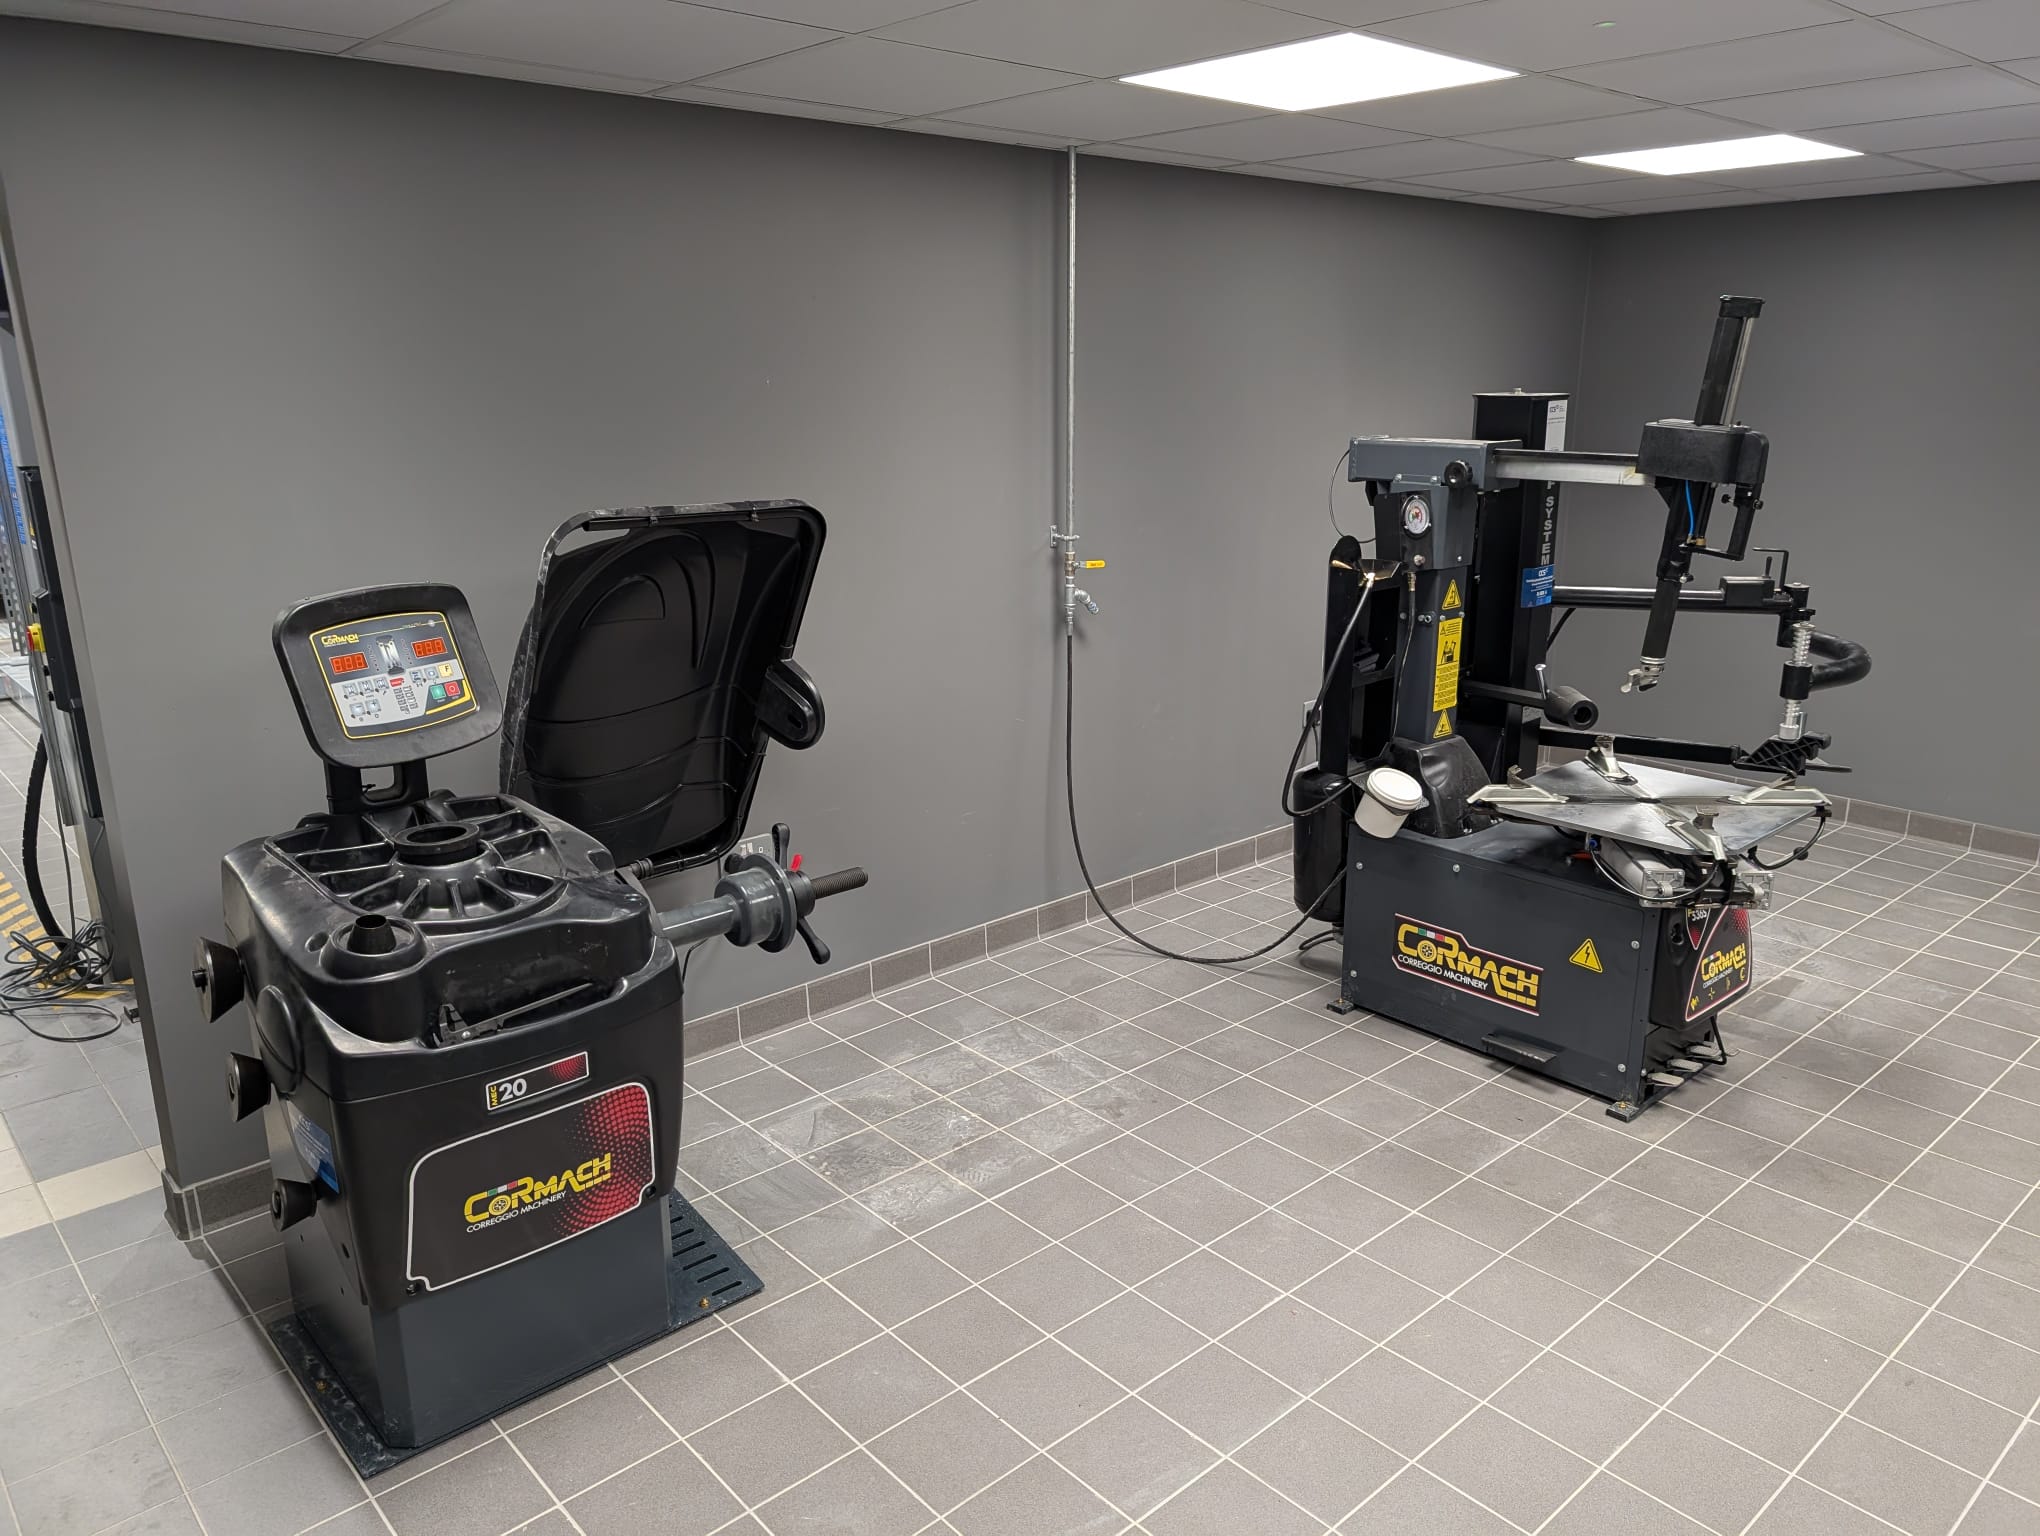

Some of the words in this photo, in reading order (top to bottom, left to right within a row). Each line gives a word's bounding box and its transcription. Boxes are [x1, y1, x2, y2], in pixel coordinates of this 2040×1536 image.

[1541, 496, 1555, 566] SYSTEM
[321, 633, 360, 645] CORMACH
[1397, 923, 1539, 1007] CORMACH
[1397, 954, 1442, 976] CORREGGIO
[1443, 969, 1489, 991] MACHINERY
[1701, 943, 1747, 981] CORMACH
[499, 1078, 527, 1102] 20
[464, 1152, 612, 1223] CORMACH
[466, 1210, 519, 1233] CORREGGIO
[520, 1190, 567, 1214] MACHINERY
